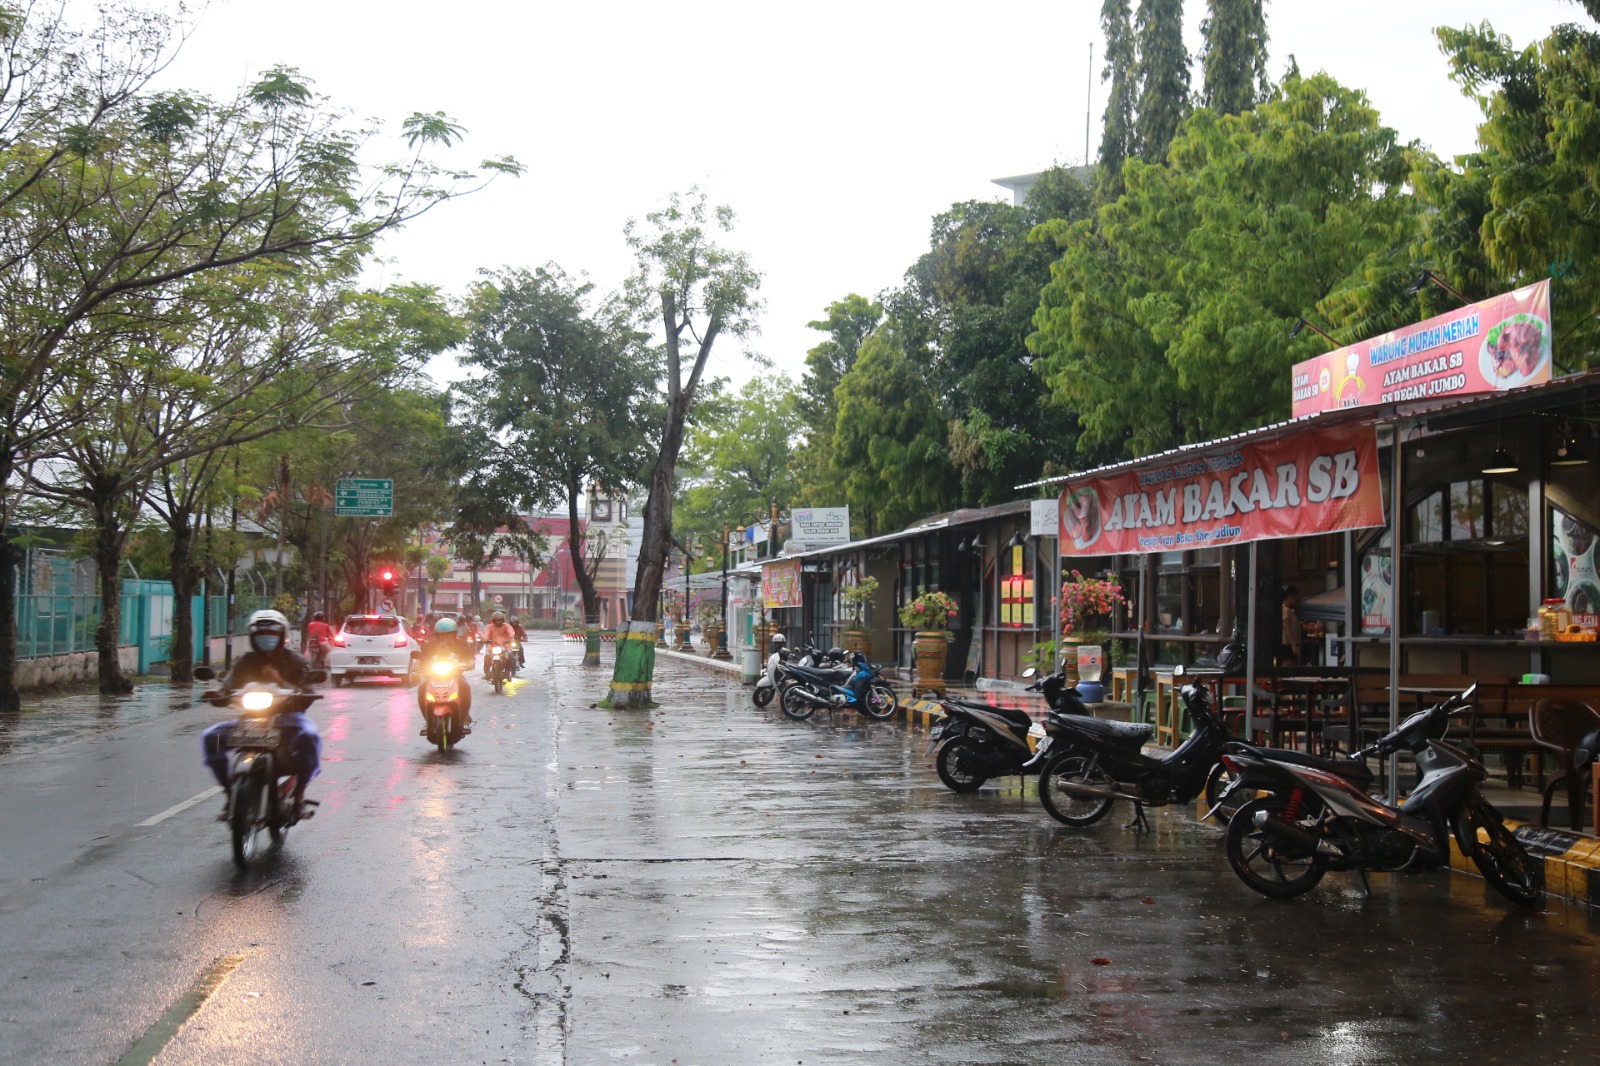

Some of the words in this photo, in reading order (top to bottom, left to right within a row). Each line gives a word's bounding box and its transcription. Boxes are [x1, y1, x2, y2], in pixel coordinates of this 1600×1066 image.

[1370, 337, 1407, 367] WARUNG
[1408, 327, 1441, 355] MURAH
[1442, 313, 1480, 345] MERIAH
[1294, 373, 1309, 389] AYAM
[1383, 367, 1410, 387] AYAM
[1411, 356, 1448, 379] BAKAR
[1449, 351, 1464, 369] SB
[1294, 386, 1312, 403] BAKAR
[1312, 384, 1319, 397] SB
[1381, 392, 1393, 403] ES
[1394, 382, 1427, 402] DEGAN
[1428, 373, 1467, 396] JUMBO
[1104, 487, 1176, 532] AYAM
[1182, 462, 1300, 524] BAKAR
[1307, 450, 1360, 504] SB
